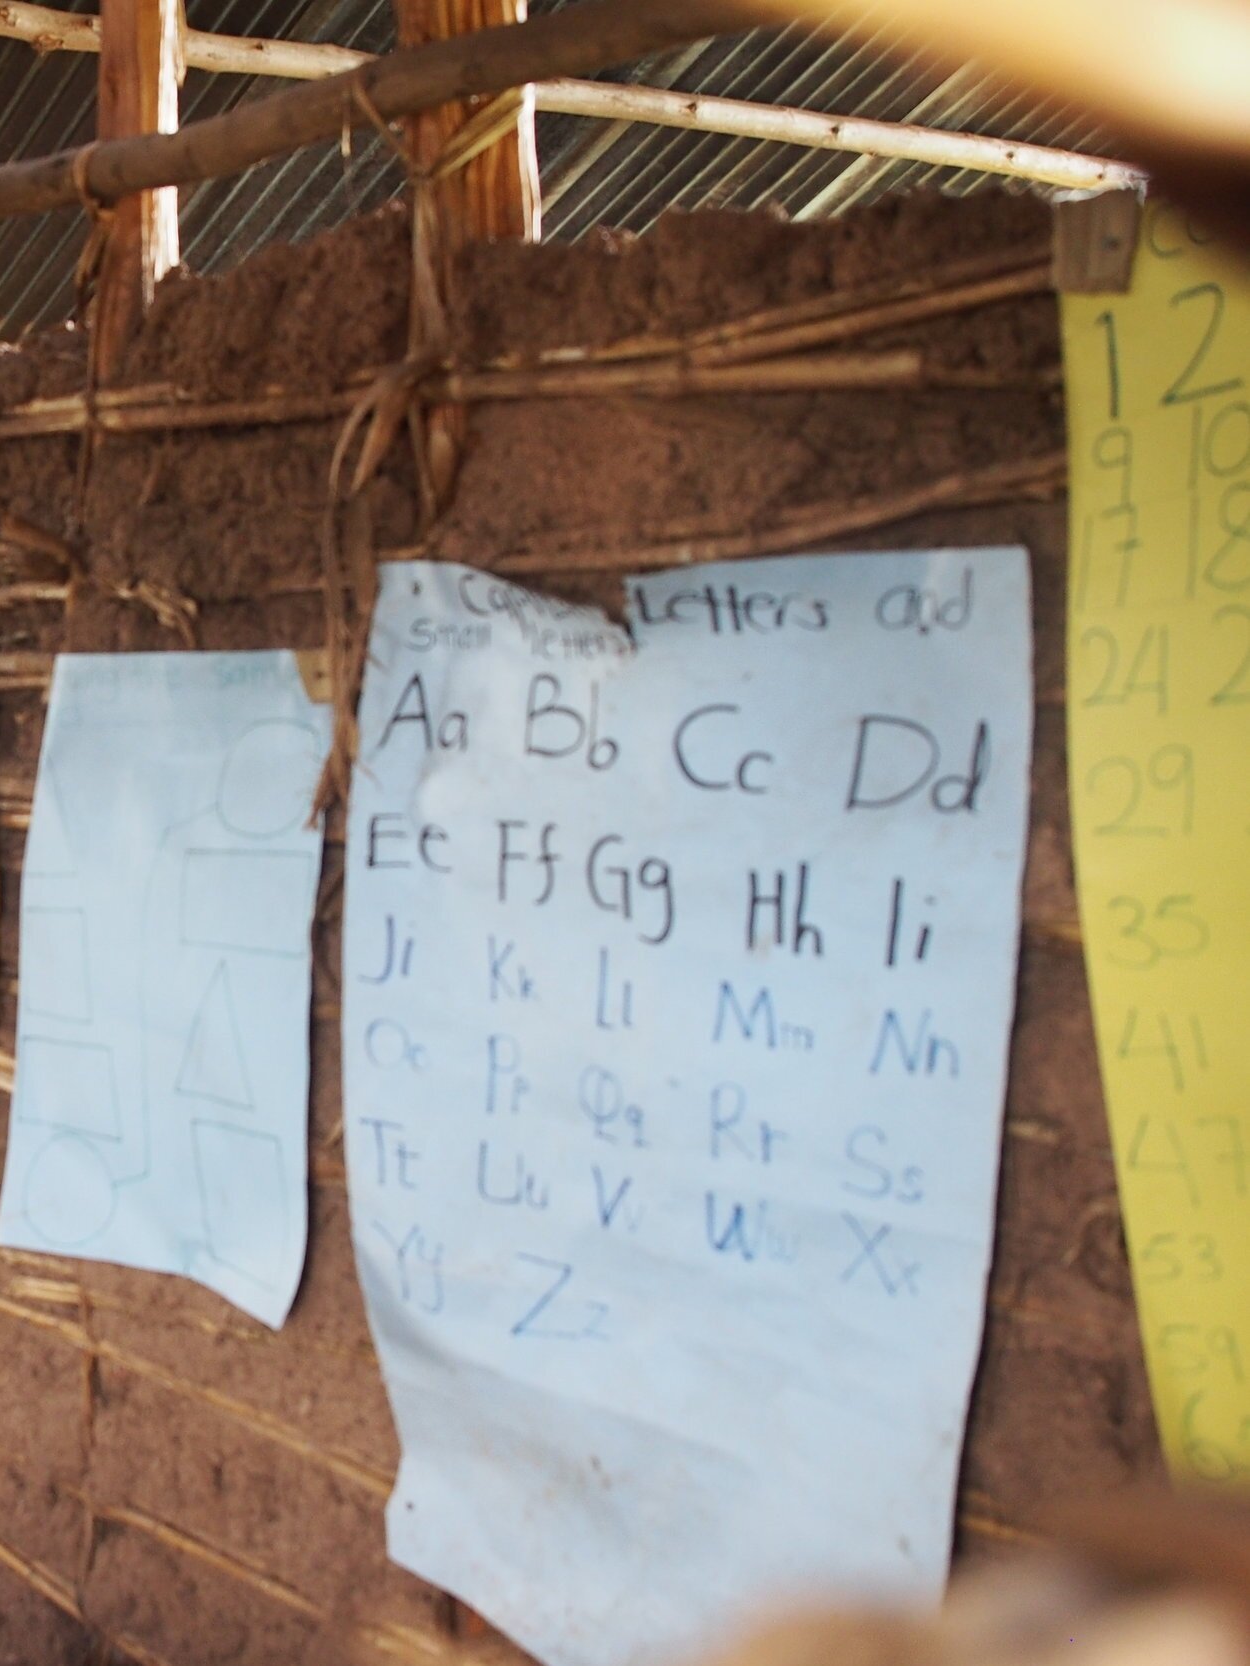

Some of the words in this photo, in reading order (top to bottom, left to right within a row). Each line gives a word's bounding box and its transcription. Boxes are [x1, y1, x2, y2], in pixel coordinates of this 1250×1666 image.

[1096, 310, 1120, 420] 1
[1160, 282, 1244, 407] 2
[377, 672, 469, 753] Aa
[523, 673, 621, 772] Bb
[672, 703, 776, 797] Cc
[845, 713, 992, 815] Dd
[496, 819, 563, 907] Ff
[585, 833, 675, 946] Gg
[746, 861, 826, 958] Hh
[710, 976, 817, 1054] Mm
[867, 1006, 963, 1082] Nn
[708, 1080, 791, 1166] Rr
[839, 1124, 926, 1207] Ss
[509, 1250, 613, 1345] Zz
